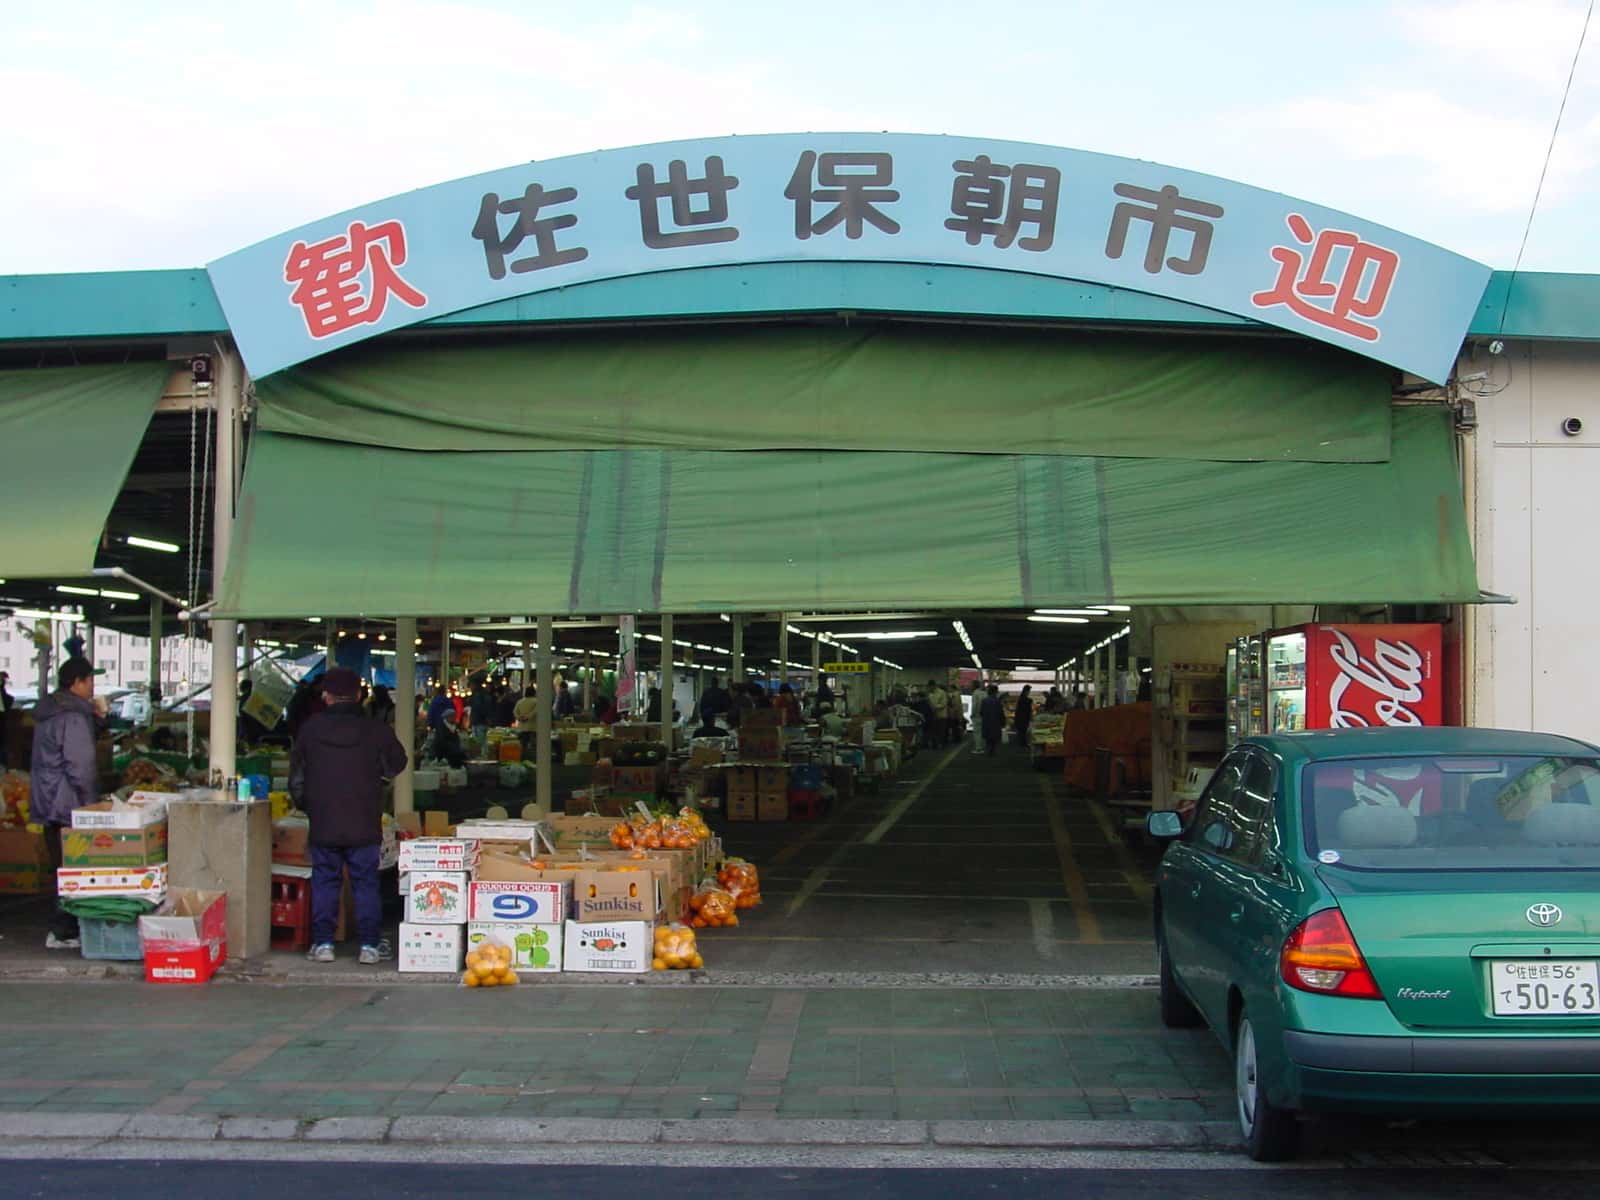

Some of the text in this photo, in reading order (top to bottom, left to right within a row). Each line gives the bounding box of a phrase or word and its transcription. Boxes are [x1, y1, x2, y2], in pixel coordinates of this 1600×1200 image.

[285, 150, 1399, 342] 歓 佐世保朝市 迎
[583, 896, 645, 914] Sunkist
[581, 927, 626, 940] Sunkist
[1517, 964, 1575, 980] 佐世保 56
[1396, 987, 1452, 1000] Hybrid
[1500, 983, 1596, 1010] て 50-63
